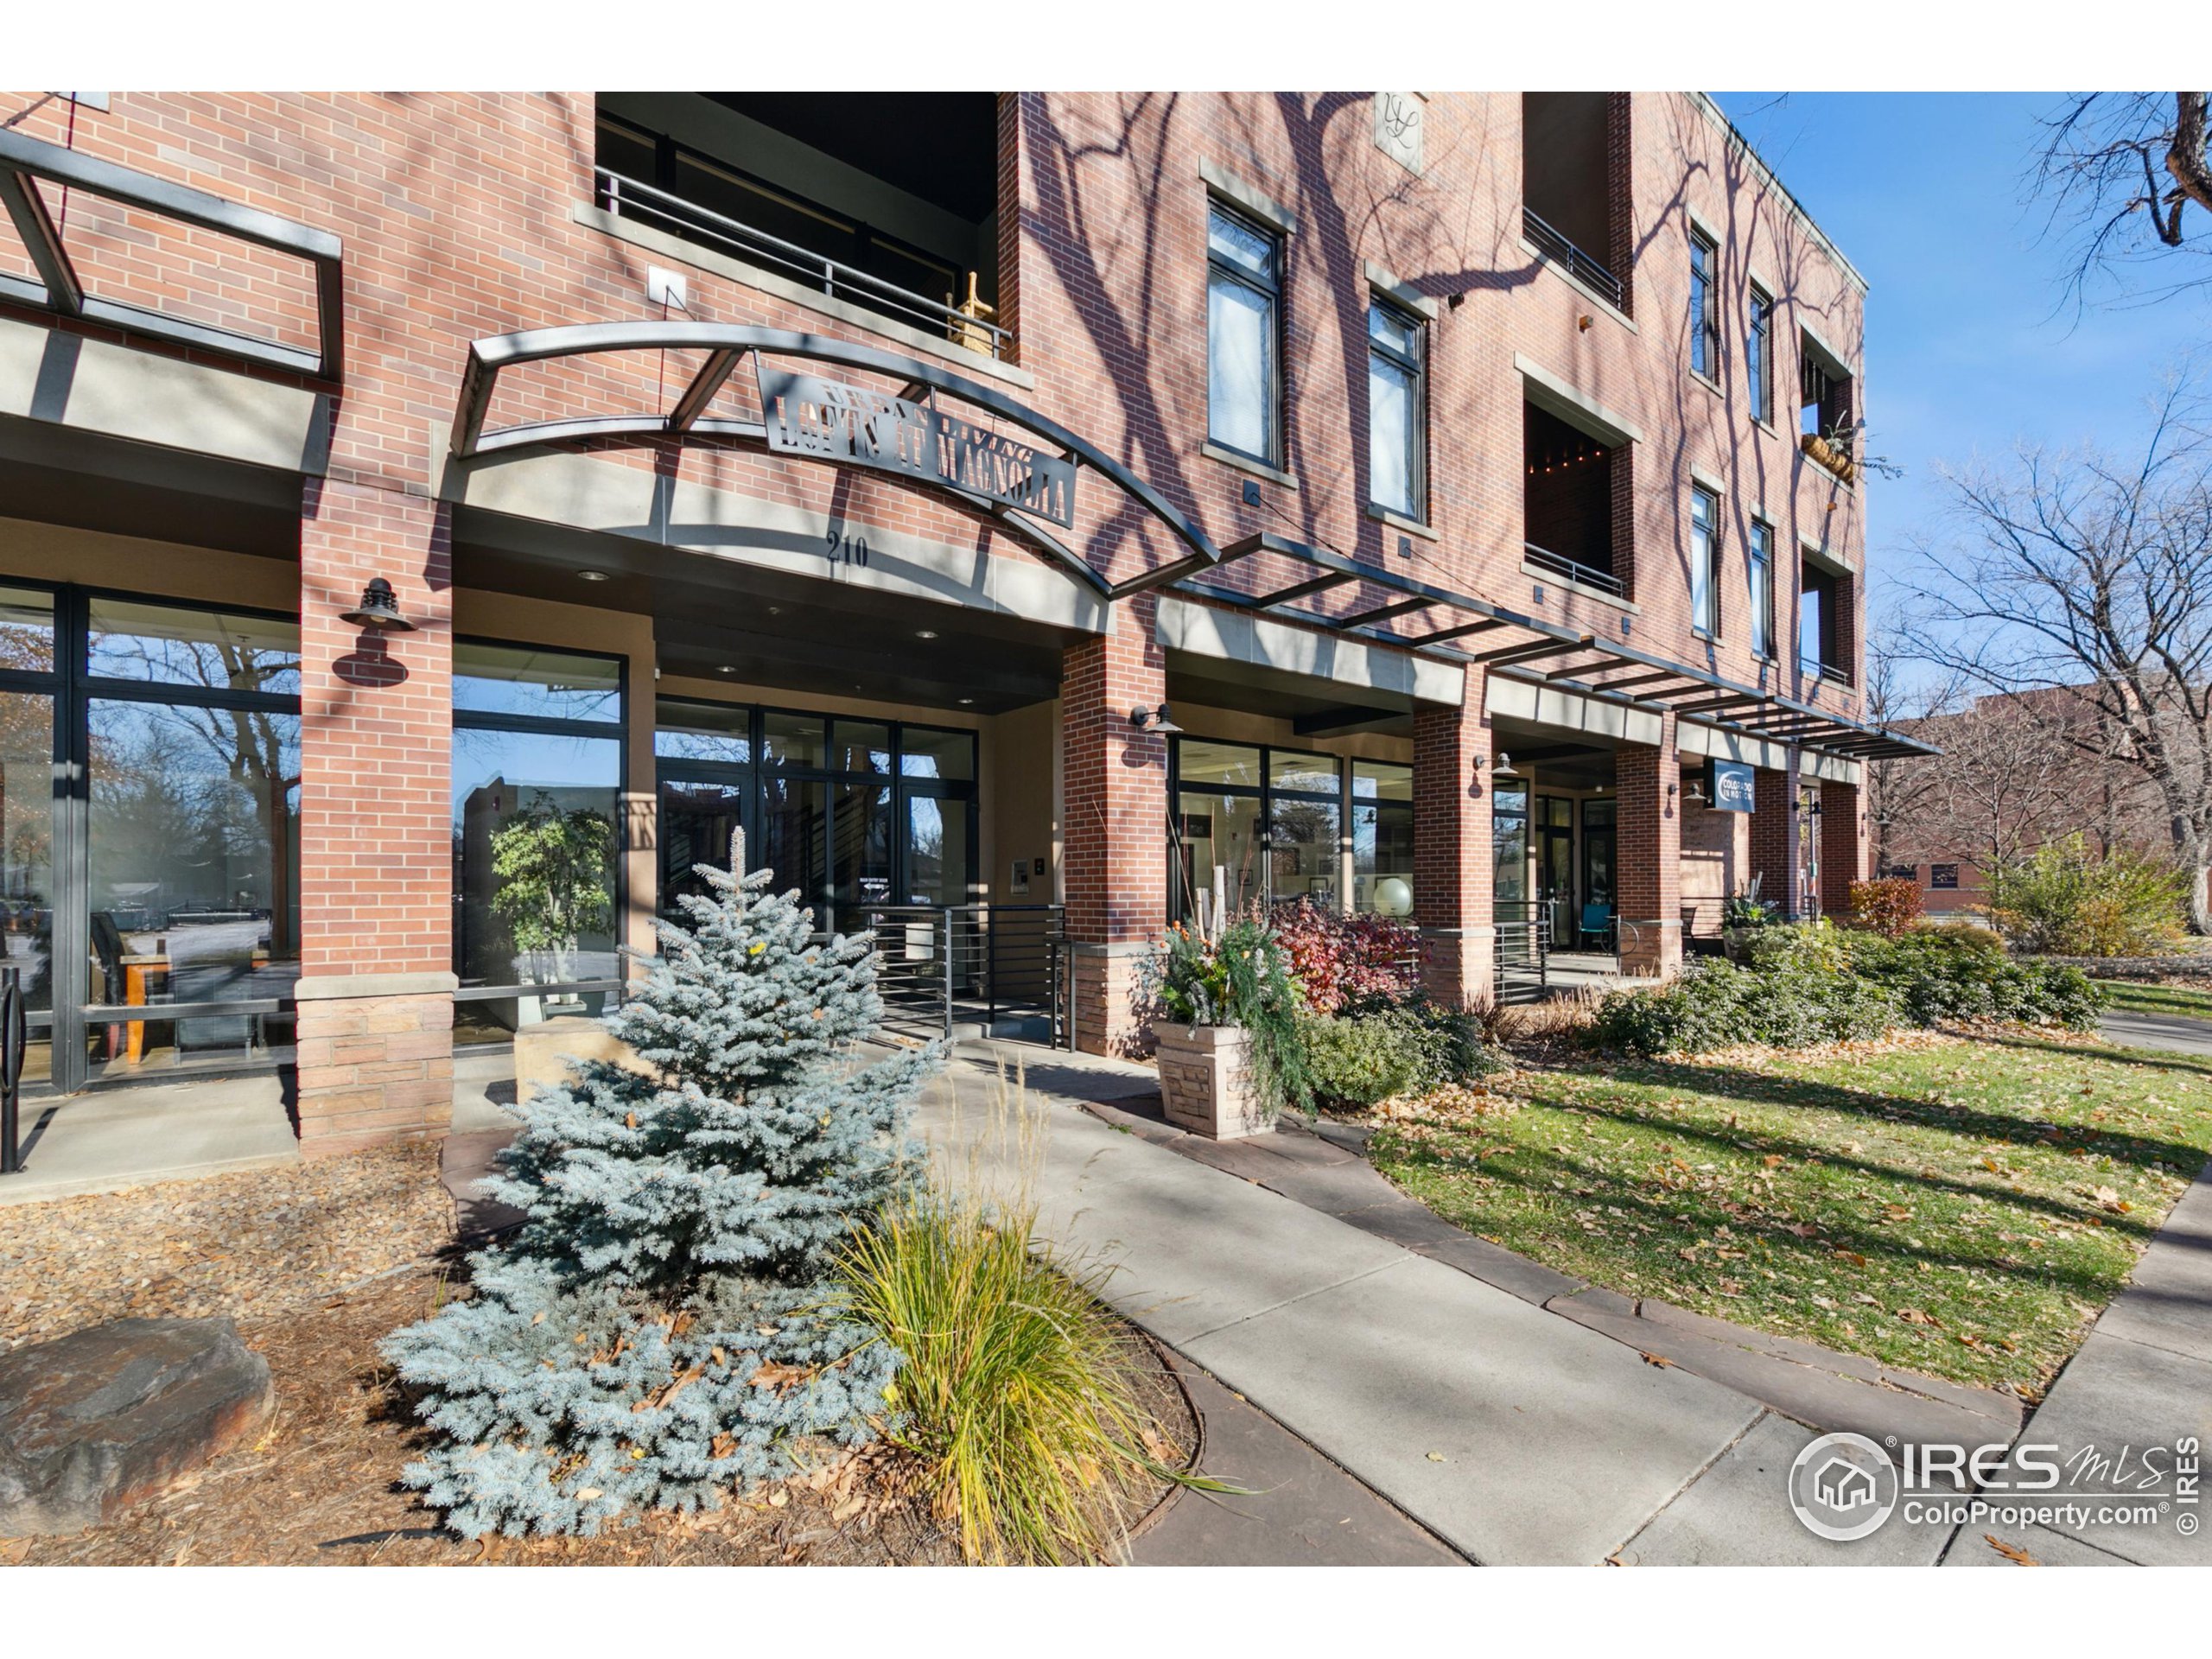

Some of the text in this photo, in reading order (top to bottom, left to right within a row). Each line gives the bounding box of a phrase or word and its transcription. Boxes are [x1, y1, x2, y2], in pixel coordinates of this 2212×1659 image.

[820, 385, 1033, 463] URBAN LIVING
[774, 397, 1066, 521] LOFTS AT MAGNOLIA
[827, 531, 868, 568] 210
[1731, 790, 1752, 800] MOTON
